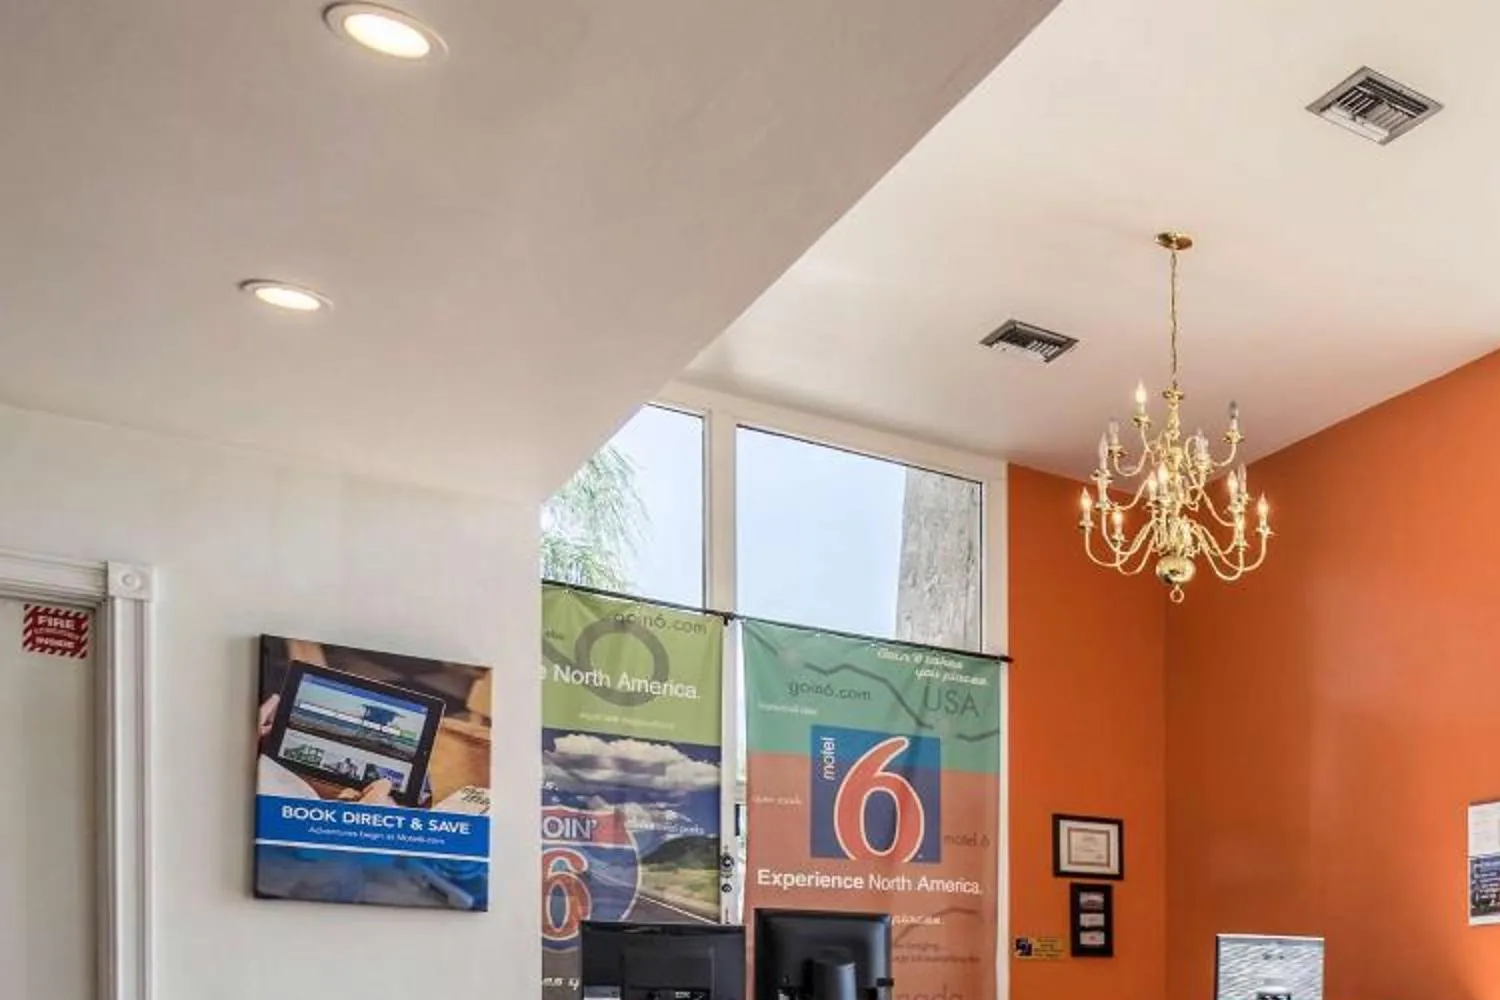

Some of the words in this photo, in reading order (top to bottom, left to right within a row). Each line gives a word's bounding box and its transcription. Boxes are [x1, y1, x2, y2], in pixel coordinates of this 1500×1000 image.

[37, 615, 75, 629] FIRE
[553, 664, 611, 688] North
[617, 672, 700, 699] America.
[788, 681, 871, 701] goin6.com
[923, 685, 979, 718] USA
[821, 736, 836, 780] motel
[834, 735, 926, 863] 6
[281, 805, 337, 824] BOOK
[343, 810, 406, 829] DIRECT
[411, 817, 423, 831] &
[428, 818, 472, 835] SAVE
[542, 816, 597, 840] OIN'
[944, 831, 976, 846] motel
[541, 847, 592, 941] 6
[757, 869, 864, 891] Experience
[868, 873, 912, 892] North
[916, 876, 983, 895] America.
